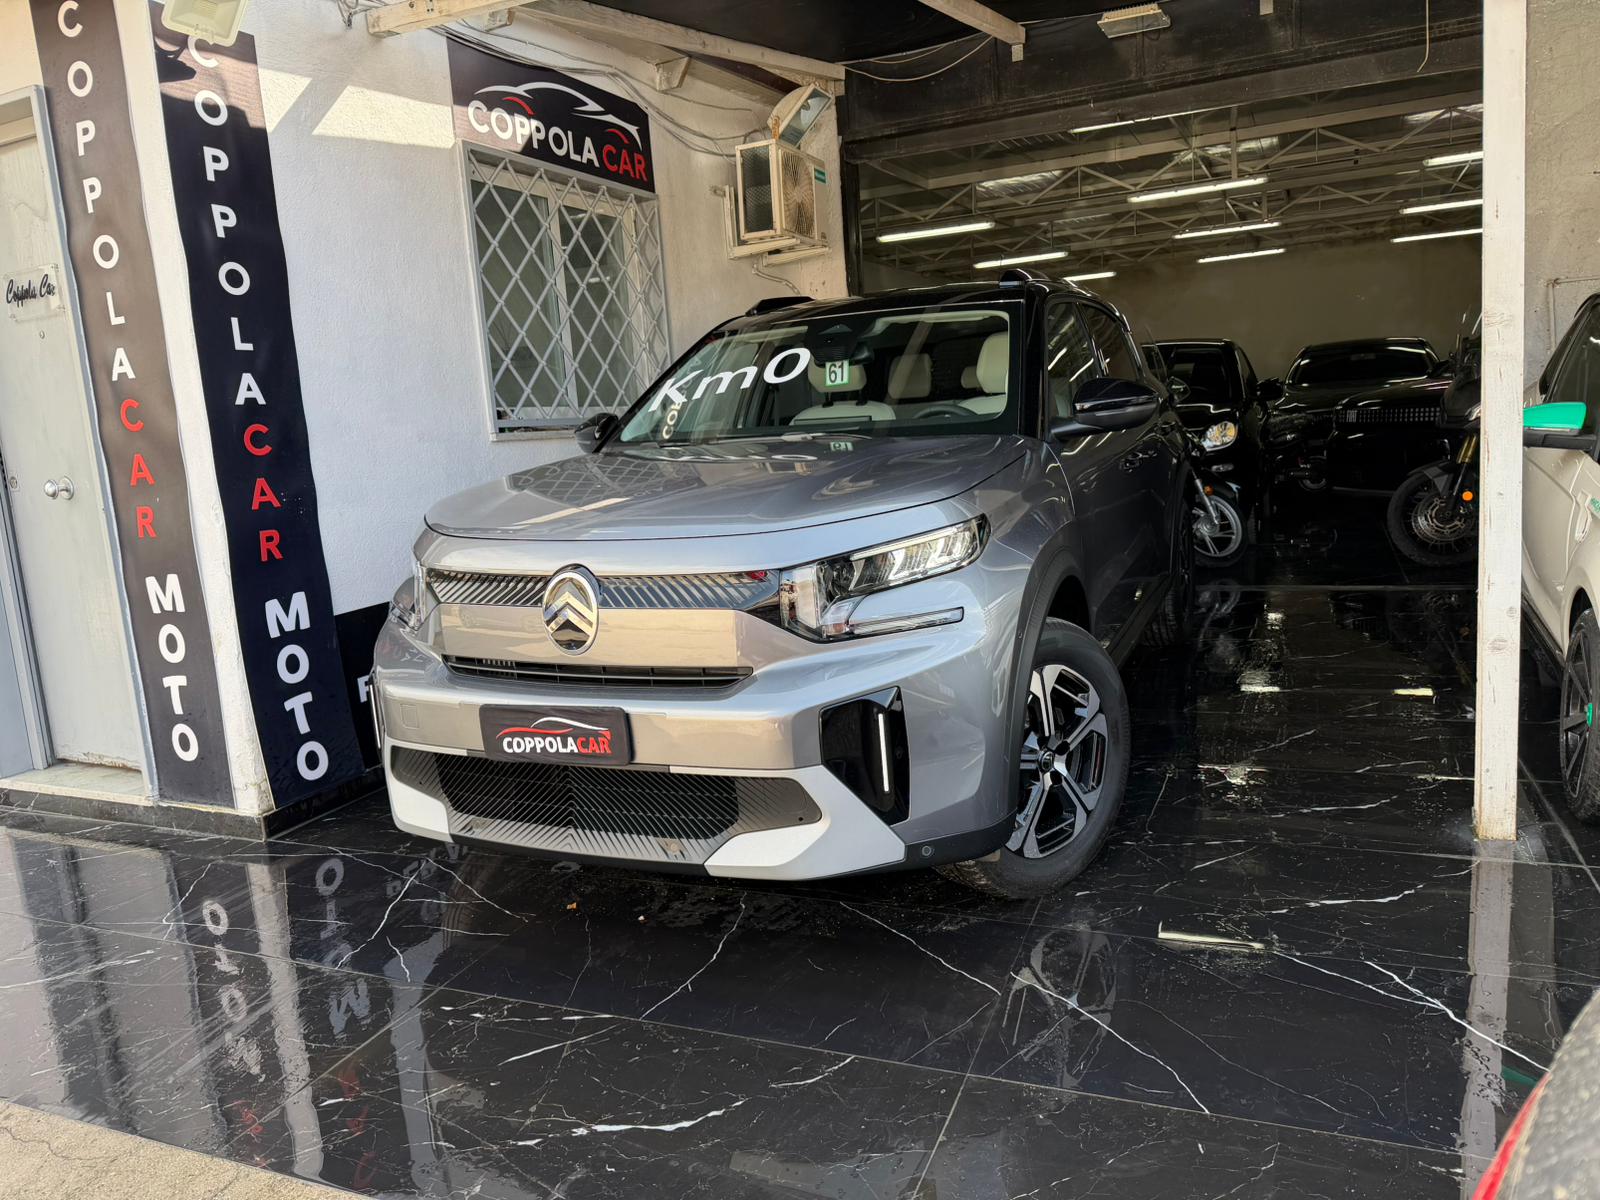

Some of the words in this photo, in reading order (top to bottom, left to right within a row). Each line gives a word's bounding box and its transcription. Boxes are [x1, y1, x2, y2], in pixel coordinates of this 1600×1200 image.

[467, 99, 600, 168] COPPOLA
[58, 0, 136, 382] COPPOLA
[120, 399, 156, 539] CAR
[145, 573, 199, 762] MOTO
[187, 35, 266, 406] COPPOLA
[243, 423, 283, 562] CAR
[265, 591, 329, 781] MOTO
[828, 362, 846, 384] 61
